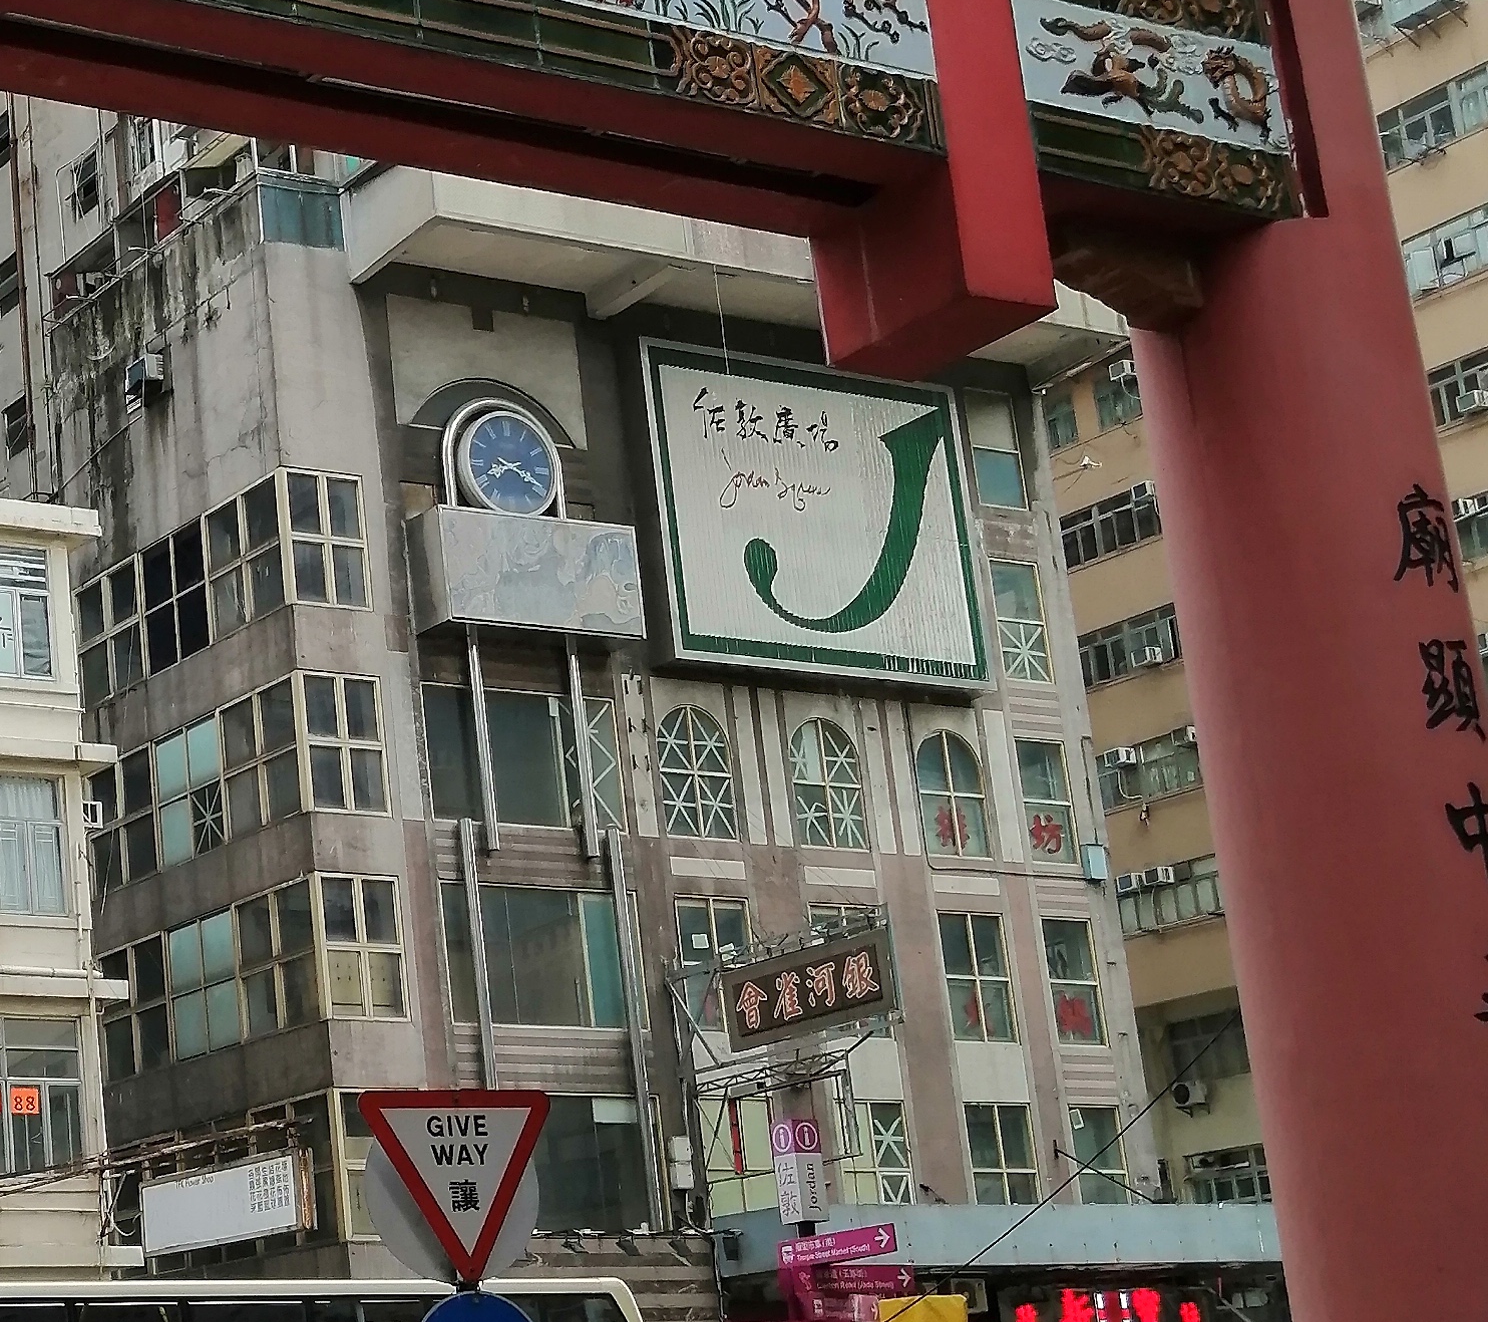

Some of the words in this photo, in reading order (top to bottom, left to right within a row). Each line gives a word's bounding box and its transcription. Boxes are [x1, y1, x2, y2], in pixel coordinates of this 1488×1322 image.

[1393, 483, 1488, 1023] 廟顯中
[13, 1095, 36, 1112] 88
[426, 1114, 489, 1138] GIVE
[430, 1143, 490, 1167] WAY
[449, 1179, 481, 1214] 讓
[777, 1162, 800, 1217] 佐敦
[806, 1163, 822, 1212] Jordan
